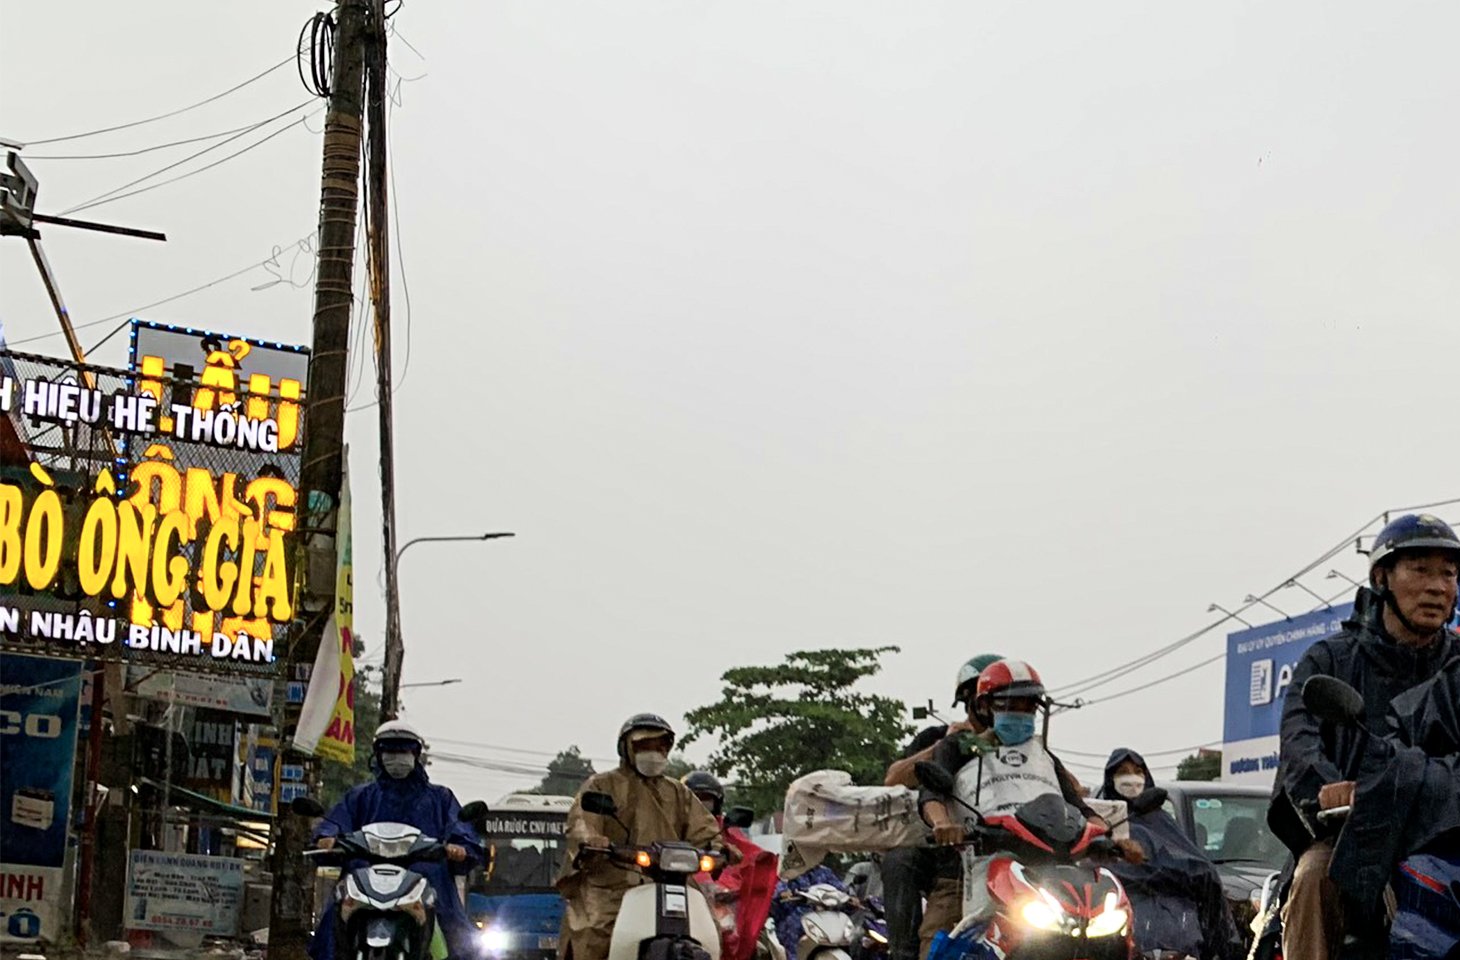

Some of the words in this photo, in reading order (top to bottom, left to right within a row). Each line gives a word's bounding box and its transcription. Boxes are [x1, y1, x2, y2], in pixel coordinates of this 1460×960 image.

[25, 376, 101, 428] HIỆU
[115, 391, 157, 438] HỆ
[172, 400, 278, 453] THỐNG
[79, 468, 190, 607] ÔNG
[31, 609, 116, 646] NHẬU
[129, 620, 201, 655] BÌNH
[211, 631, 274, 663] DÂN
